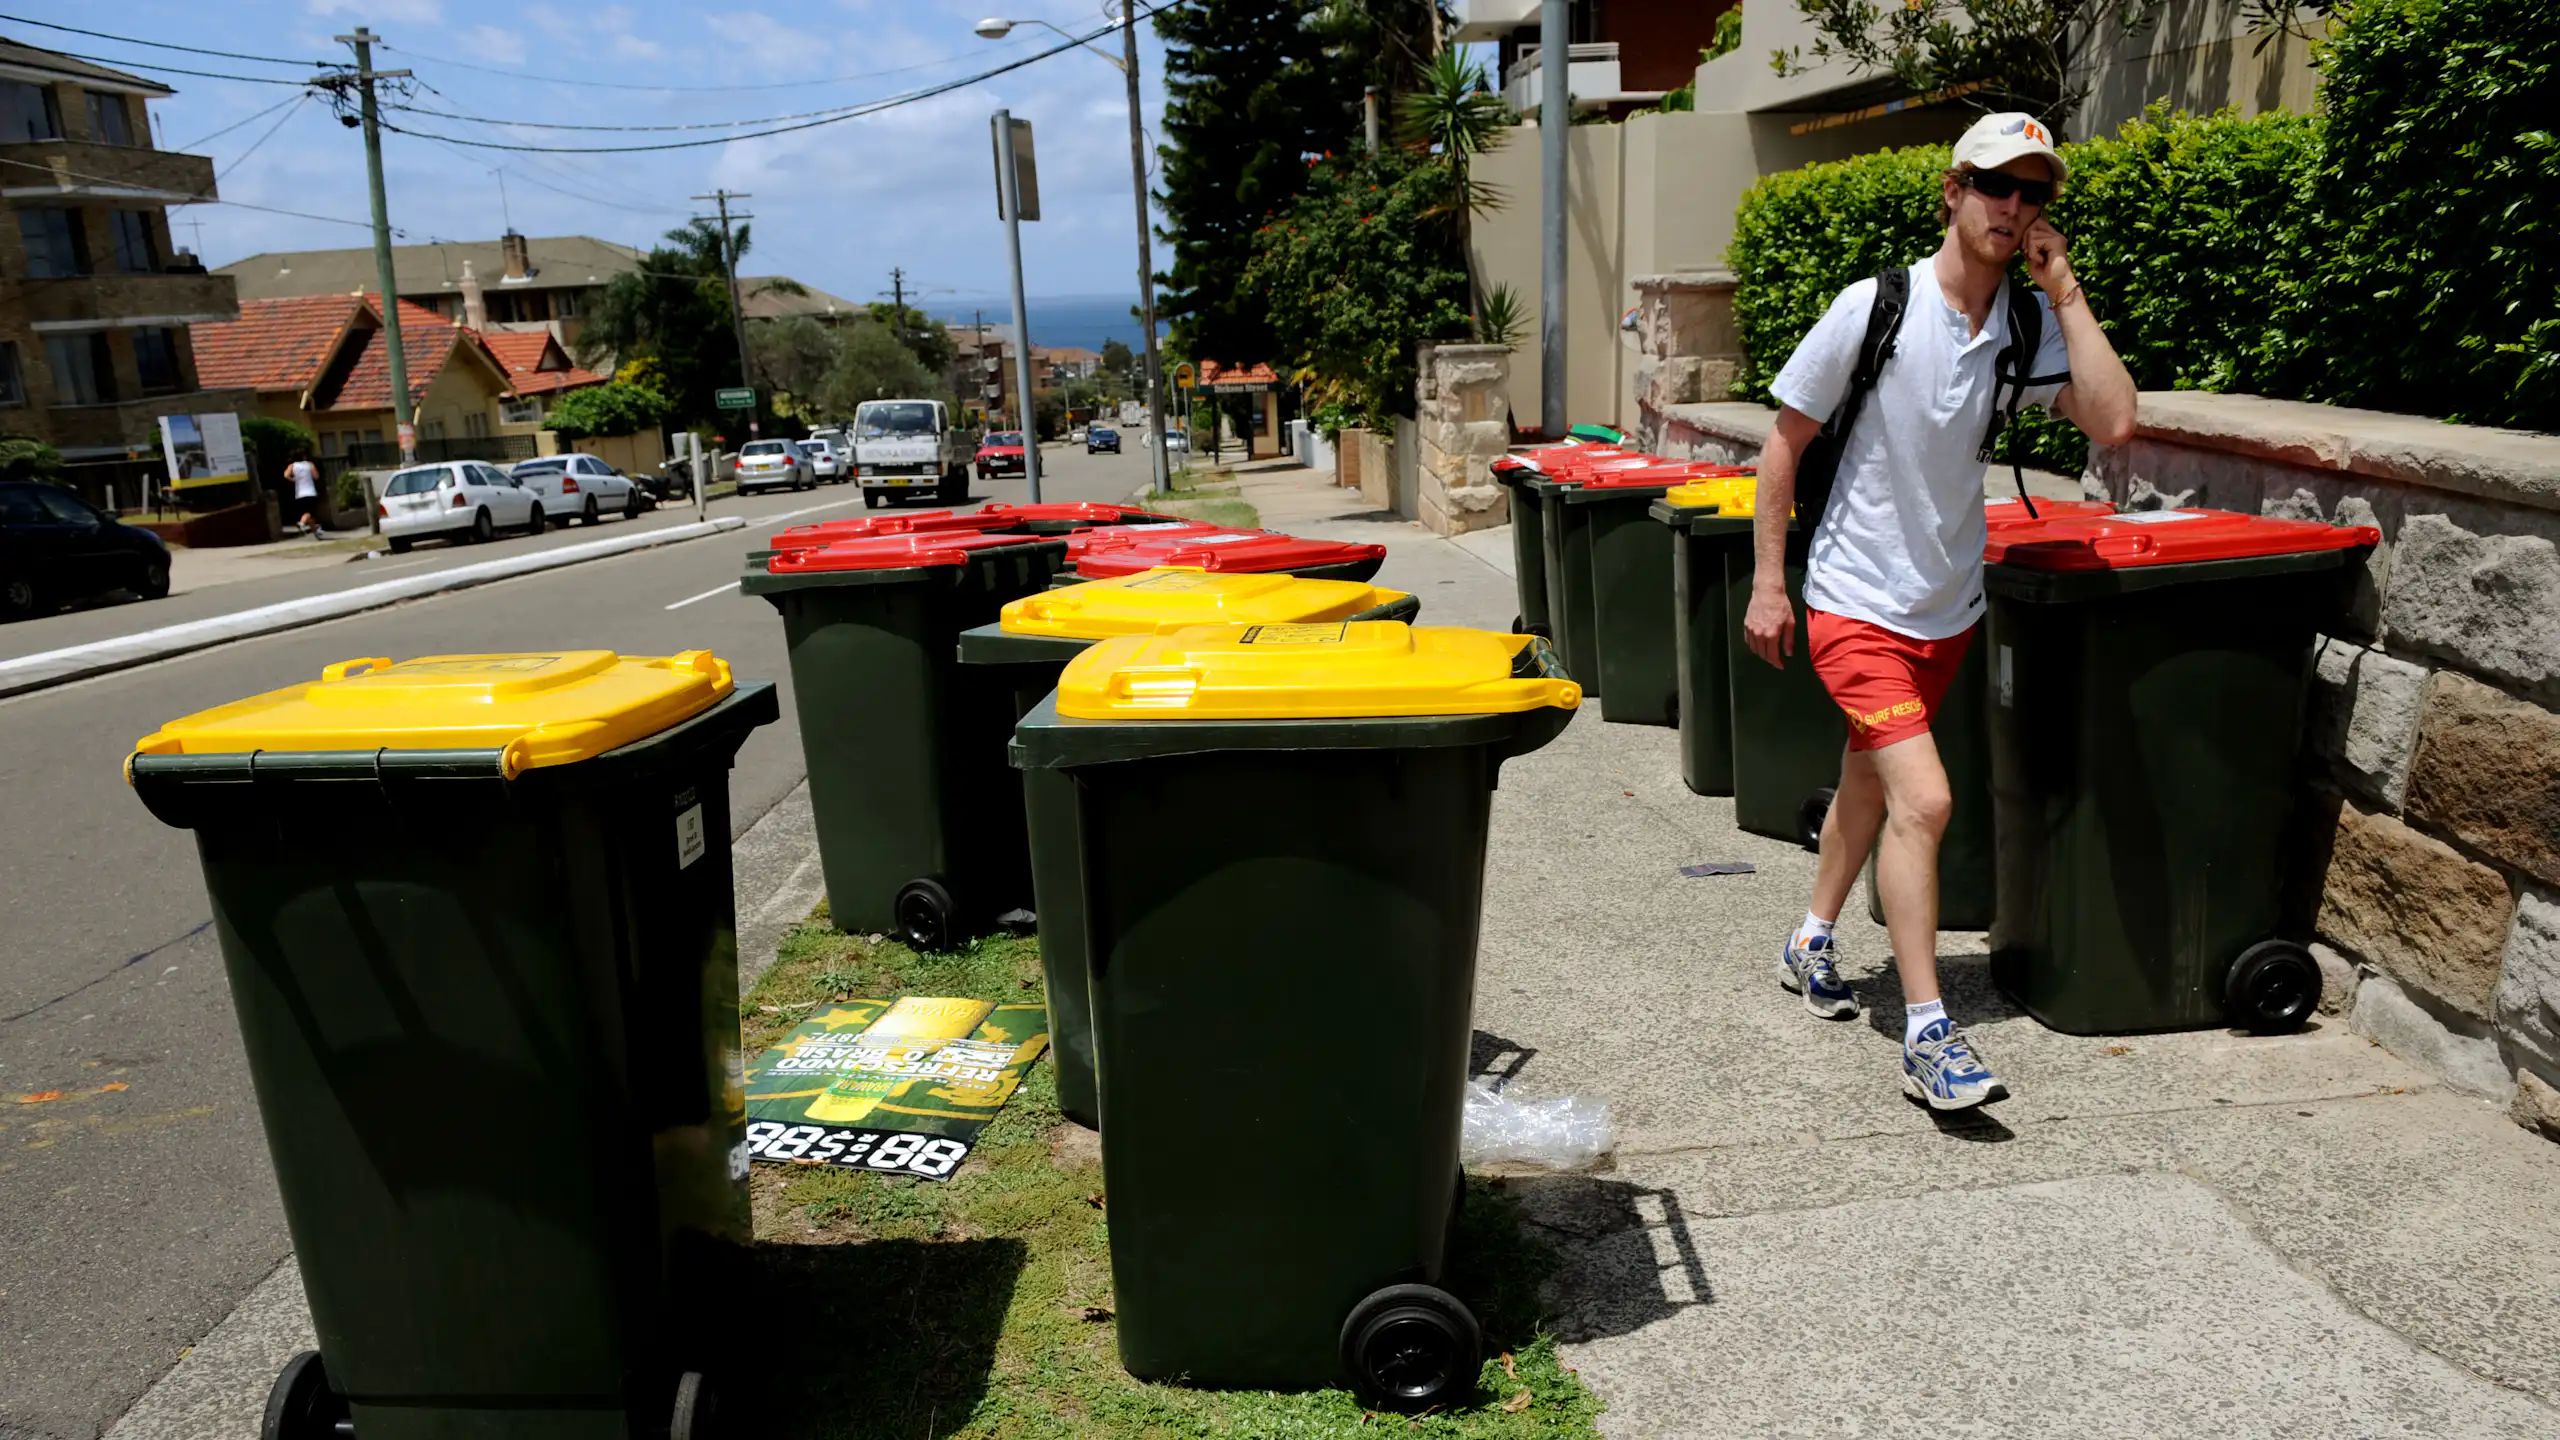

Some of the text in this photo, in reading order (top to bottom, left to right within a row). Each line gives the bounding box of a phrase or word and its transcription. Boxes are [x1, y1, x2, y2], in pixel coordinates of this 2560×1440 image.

[1245, 384, 1268, 392] Street
[1864, 708, 1890, 725] SURF
[795, 1046, 890, 1063] BRASIL
[903, 1050, 924, 1061] O
[776, 1057, 1000, 1082] REFRESCANDO
[841, 1132, 881, 1163] FOR
[867, 1134, 968, 1175] 88
